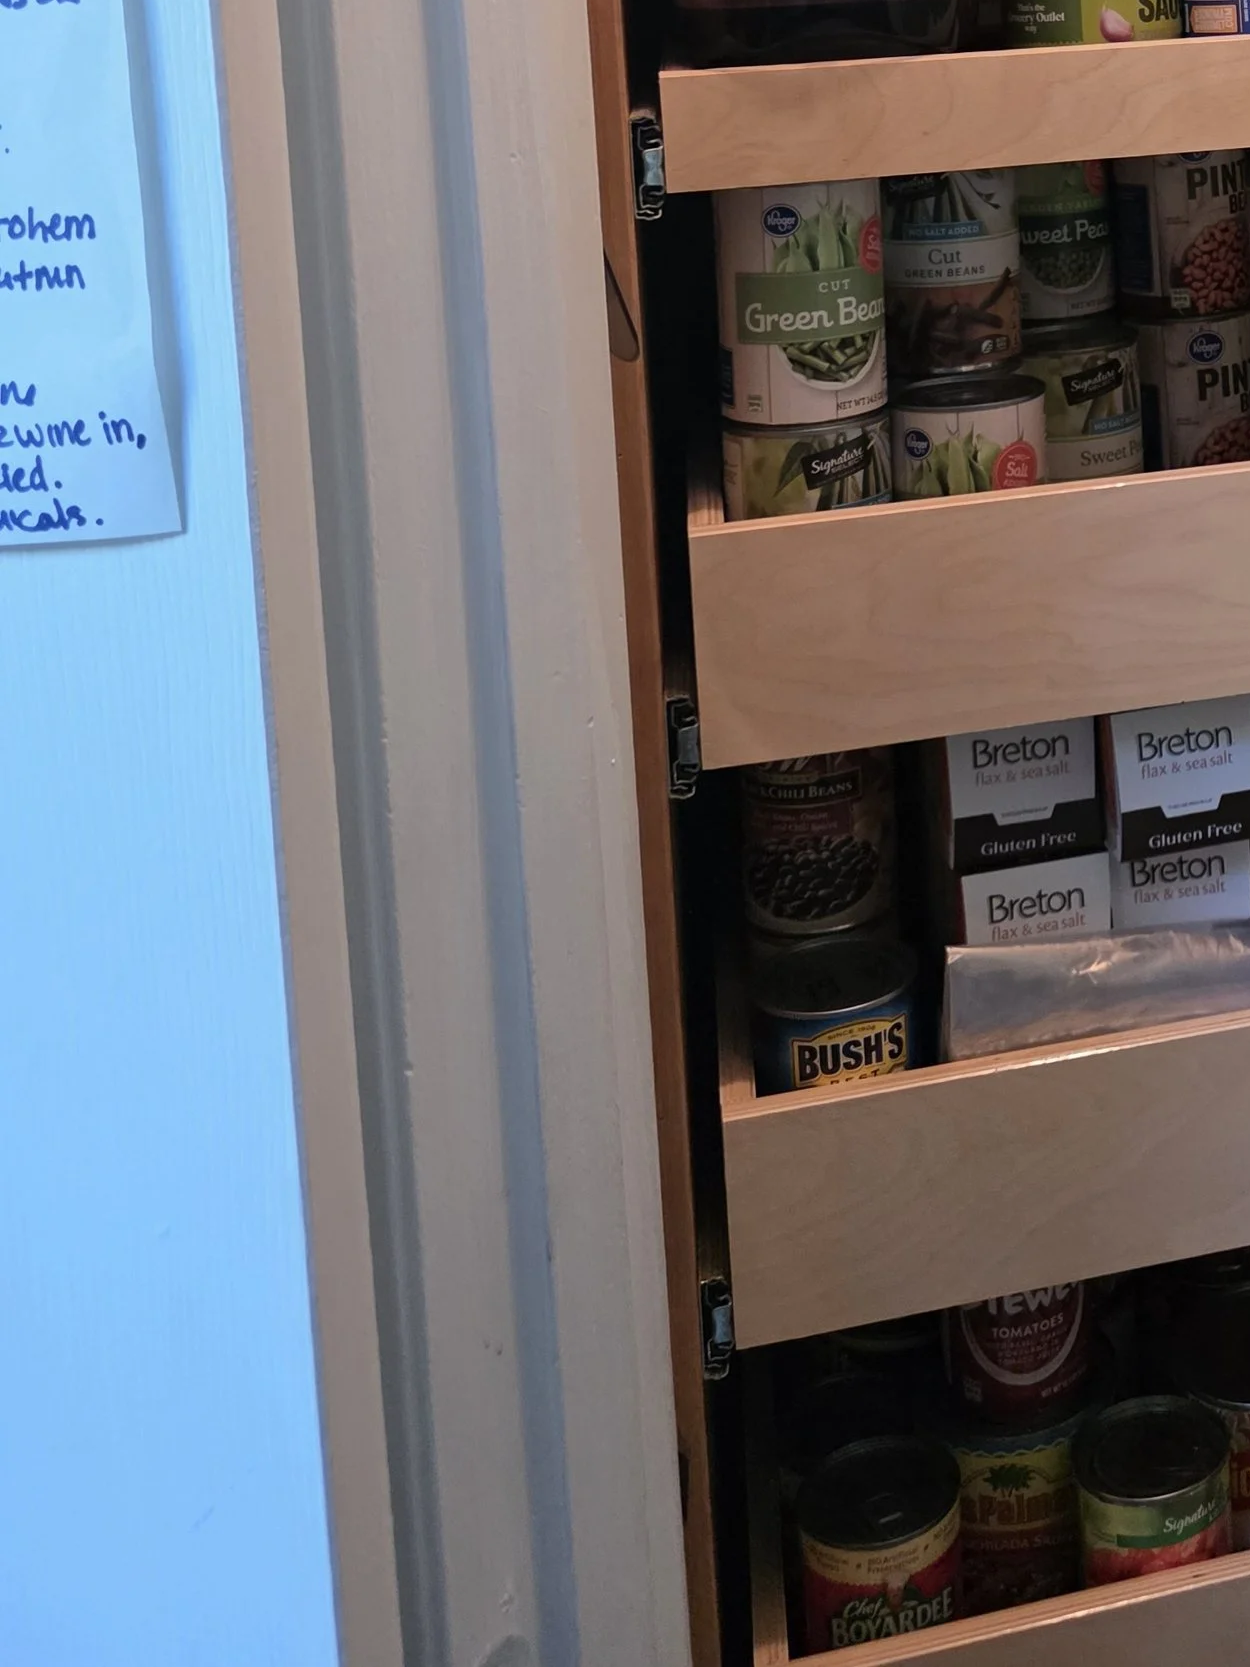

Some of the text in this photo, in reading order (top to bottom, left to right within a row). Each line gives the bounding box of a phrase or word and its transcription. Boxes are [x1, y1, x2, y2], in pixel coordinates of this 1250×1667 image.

[1186, 156, 1246, 201] PINT
[767, 210, 796, 231] Kroger
[927, 247, 963, 266] Cut
[818, 278, 851, 294] CUT
[904, 264, 986, 280] GREEN BEANS
[744, 296, 886, 333] Green Bean
[1192, 336, 1221, 359] Kroger
[810, 447, 865, 476] Signature
[1004, 461, 1029, 478] Salt
[1080, 448, 1129, 467] Sweet
[972, 734, 1070, 770] Breton
[1137, 725, 1233, 764] Breton
[975, 760, 1070, 789] flax & sea salt
[1141, 751, 1233, 780] flax & sea salt
[808, 779, 854, 799] BEANS
[981, 829, 1078, 857] Gluten Free
[1148, 820, 1243, 850] Gluten Free
[1130, 853, 1226, 888] Breton
[988, 886, 1086, 925] Breton
[1134, 878, 1226, 905] flax & sea salt
[992, 914, 1087, 942] flax & sea salt
[797, 1021, 905, 1082] BUSH'S
[991, 1312, 1065, 1339] TOMATOES
[1163, 1500, 1217, 1536] Signature
[831, 1585, 954, 1648] BOYARDEE
[842, 1596, 885, 1620] Chef
